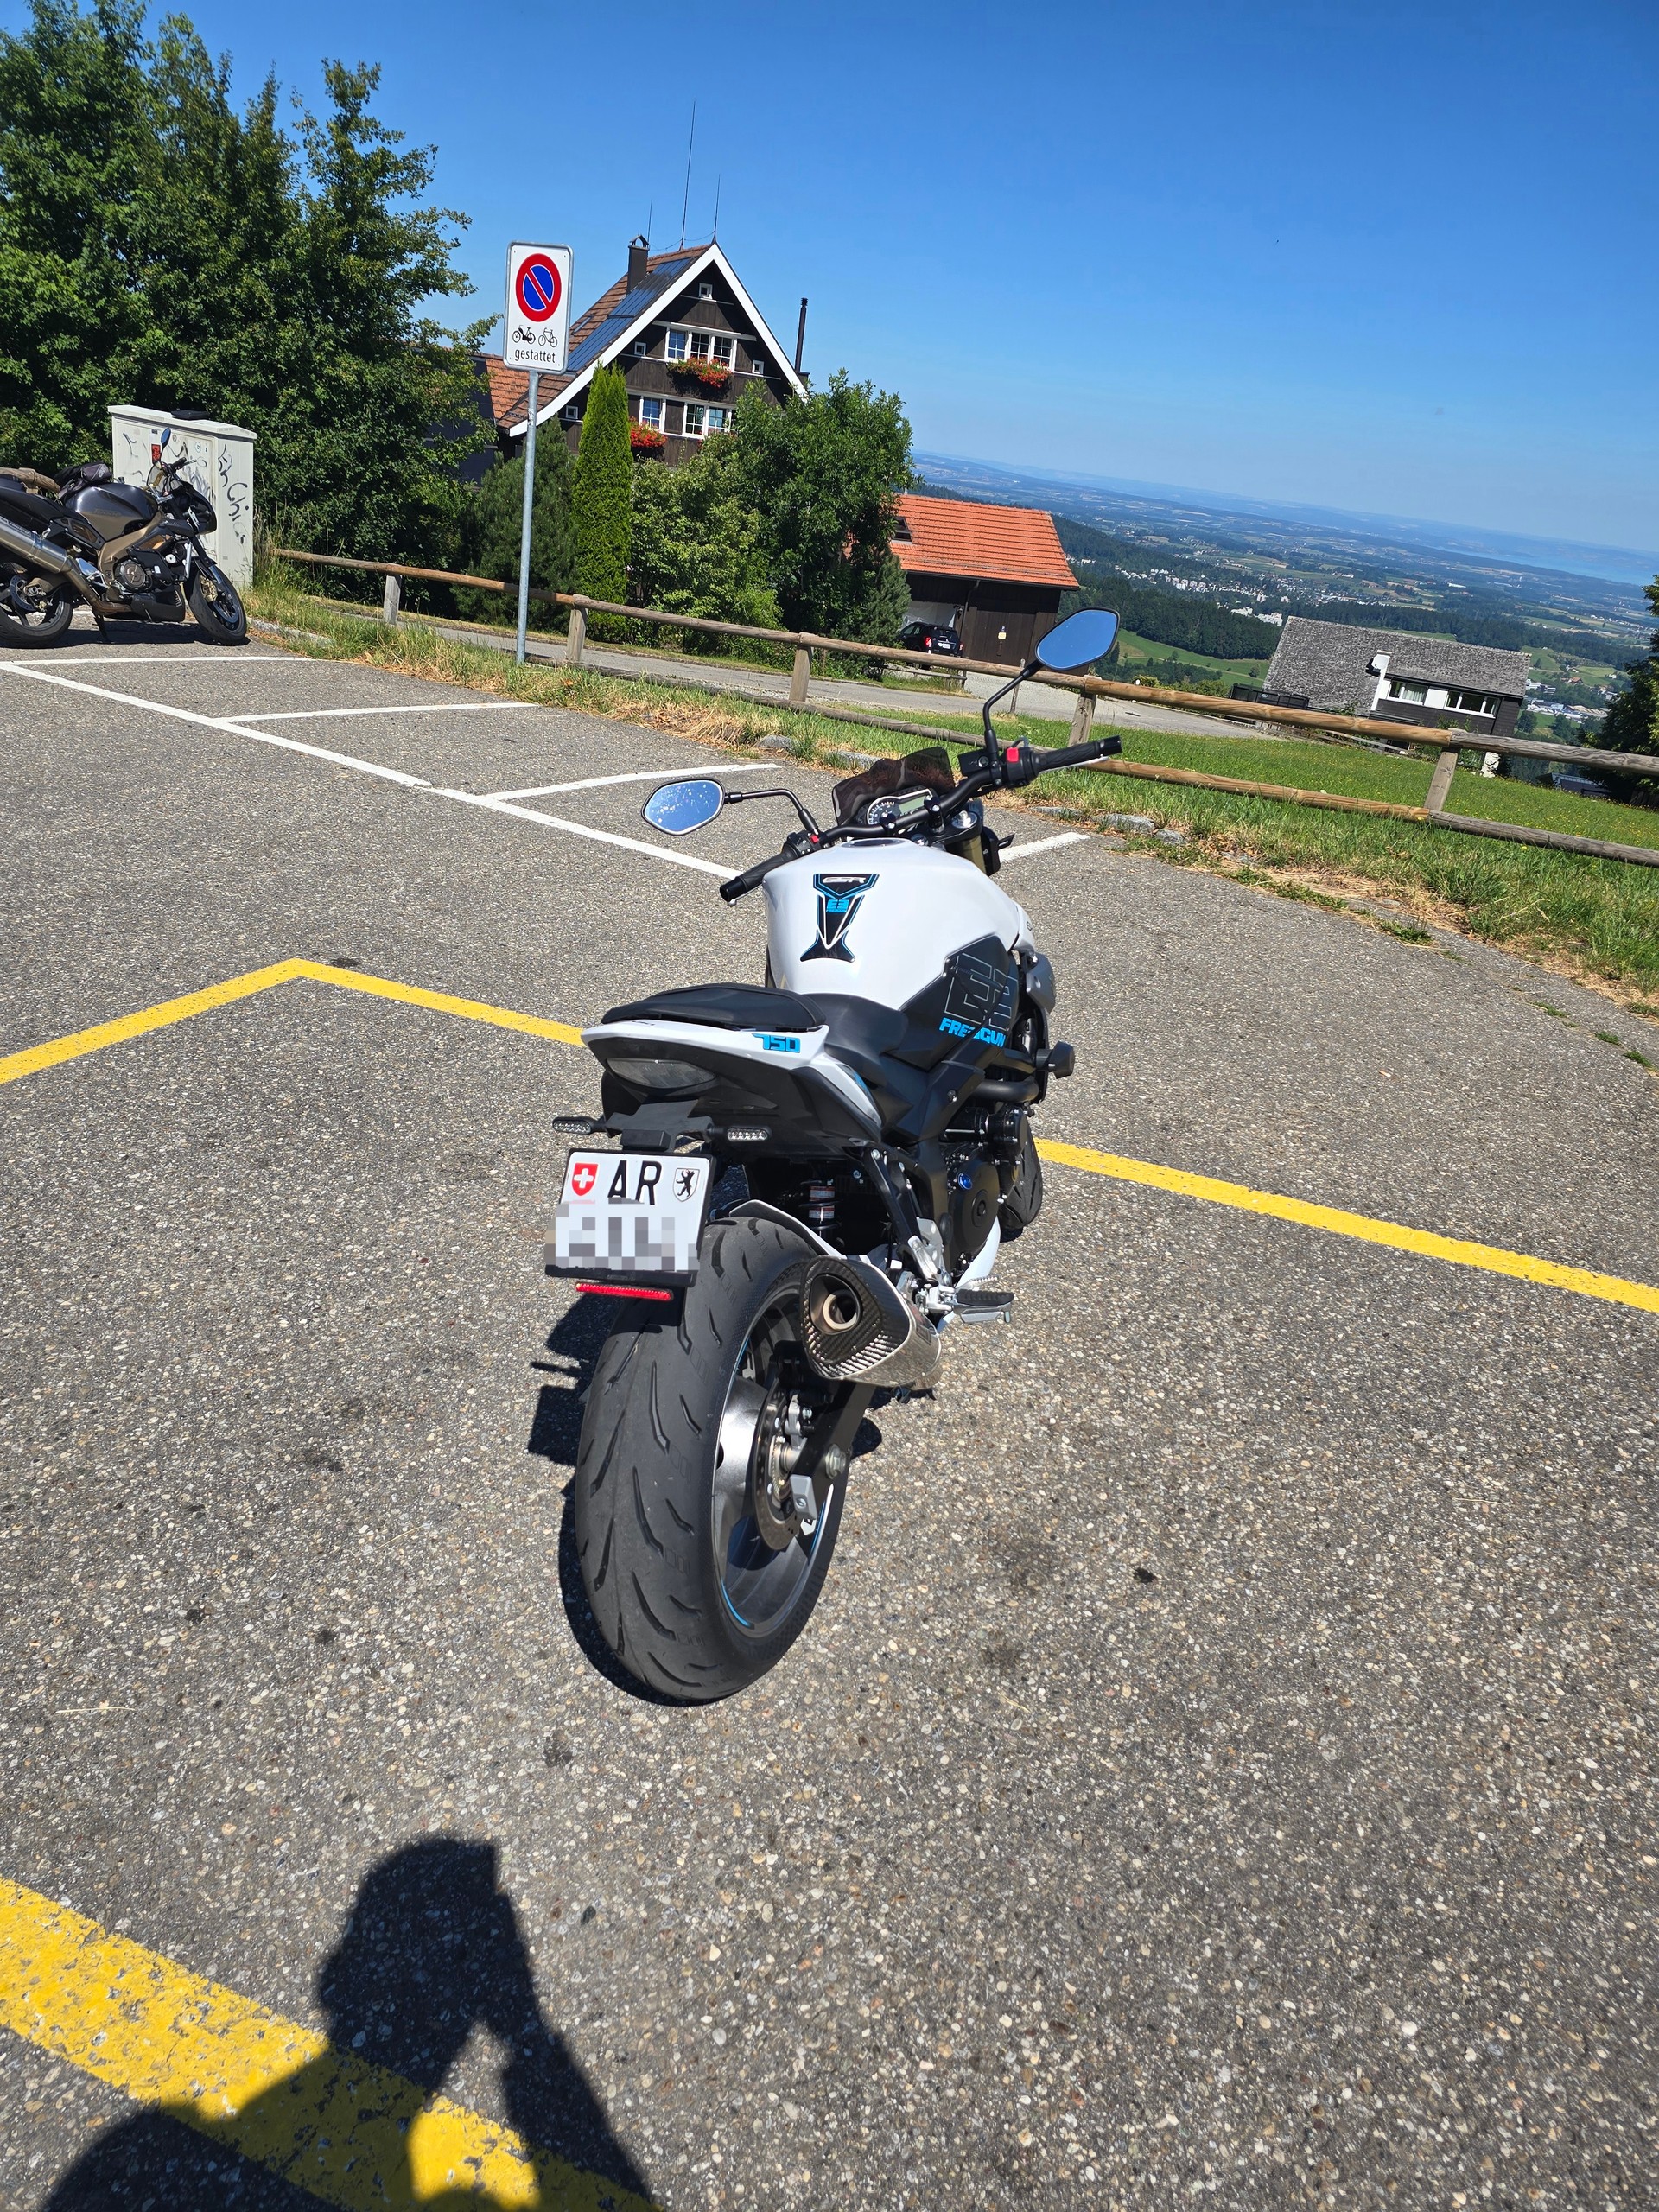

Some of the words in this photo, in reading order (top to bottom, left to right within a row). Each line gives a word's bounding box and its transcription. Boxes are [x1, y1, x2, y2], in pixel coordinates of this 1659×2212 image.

[515, 349, 556, 364] gestattet
[751, 1033, 801, 1053] 750
[607, 1159, 663, 1205] AR
